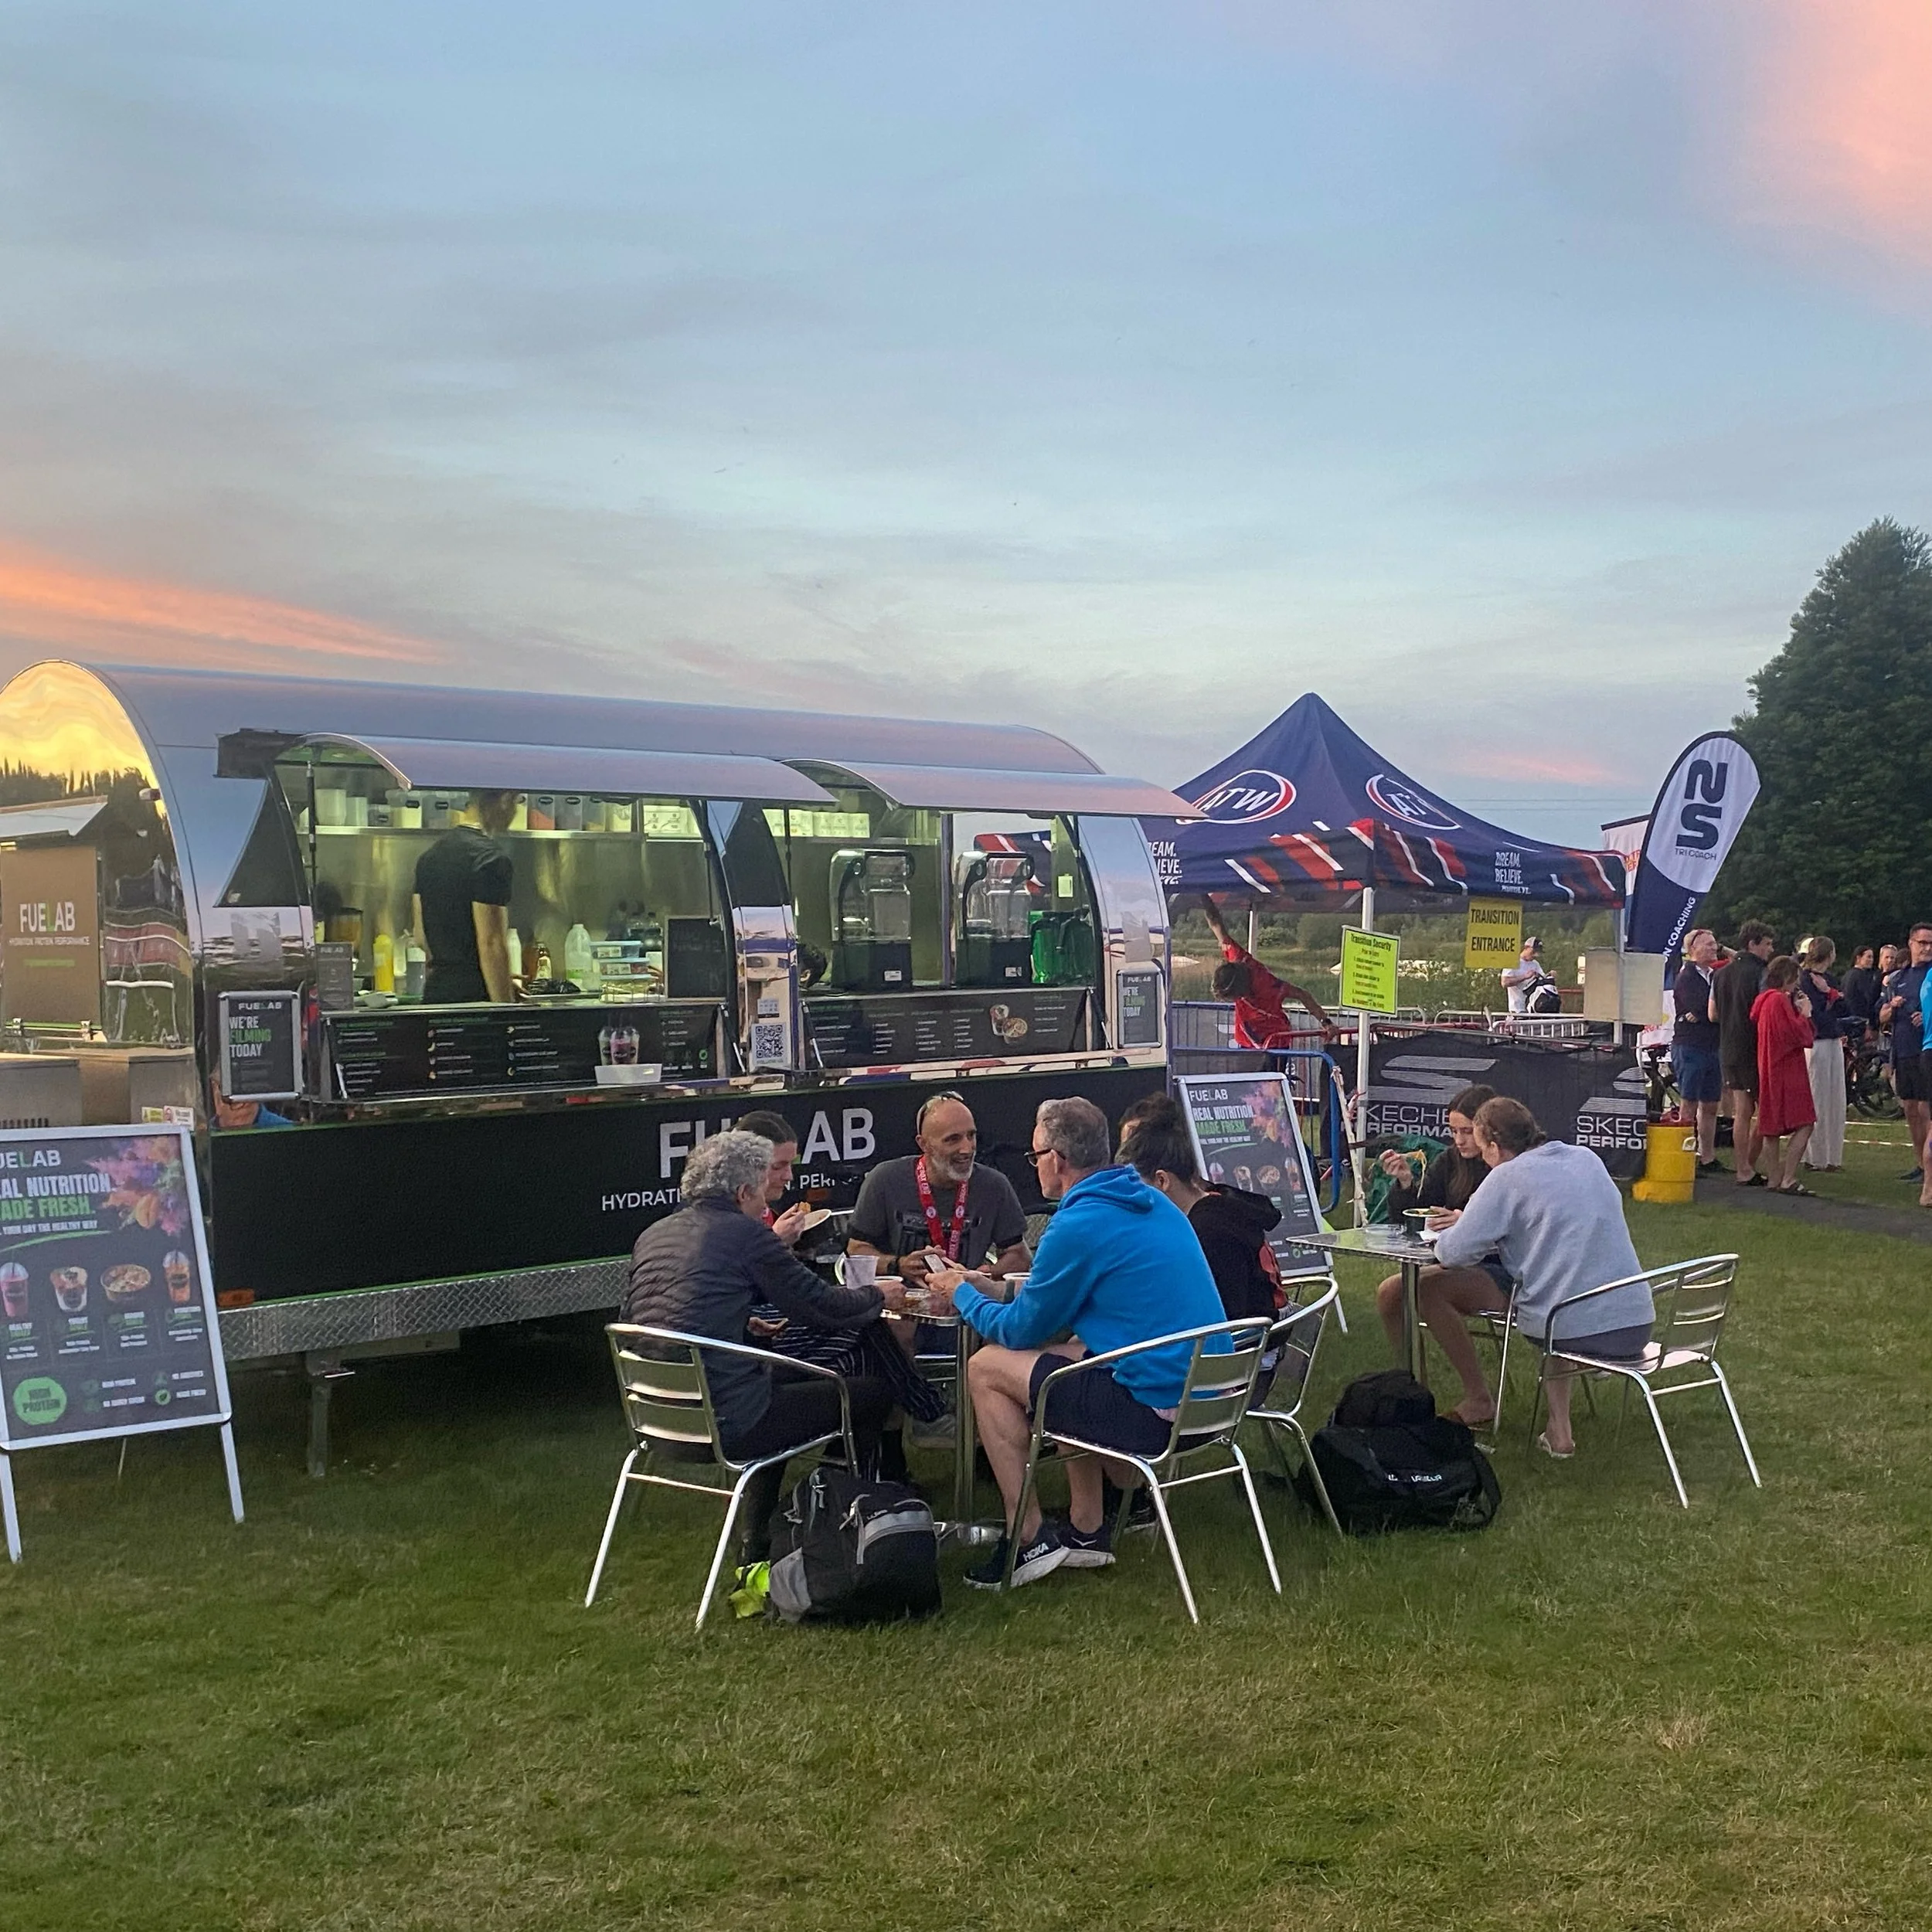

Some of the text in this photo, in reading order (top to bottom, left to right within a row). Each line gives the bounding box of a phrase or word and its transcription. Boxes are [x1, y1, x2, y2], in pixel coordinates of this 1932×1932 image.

[1199, 787, 1280, 811] ATW
[1471, 909, 1519, 925] TRANSITION
[1668, 896, 1696, 946] COACHING
[1471, 936, 1515, 952] ENTRANCE
[230, 1016, 259, 1029] WE'RE
[230, 1029, 271, 1043] FILMING
[230, 1043, 263, 1057] TODAY
[1189, 1089, 1229, 1102] FUELAB
[1192, 1107, 1214, 1121] REAL
[1022, 1543, 1049, 1562] HOKA
